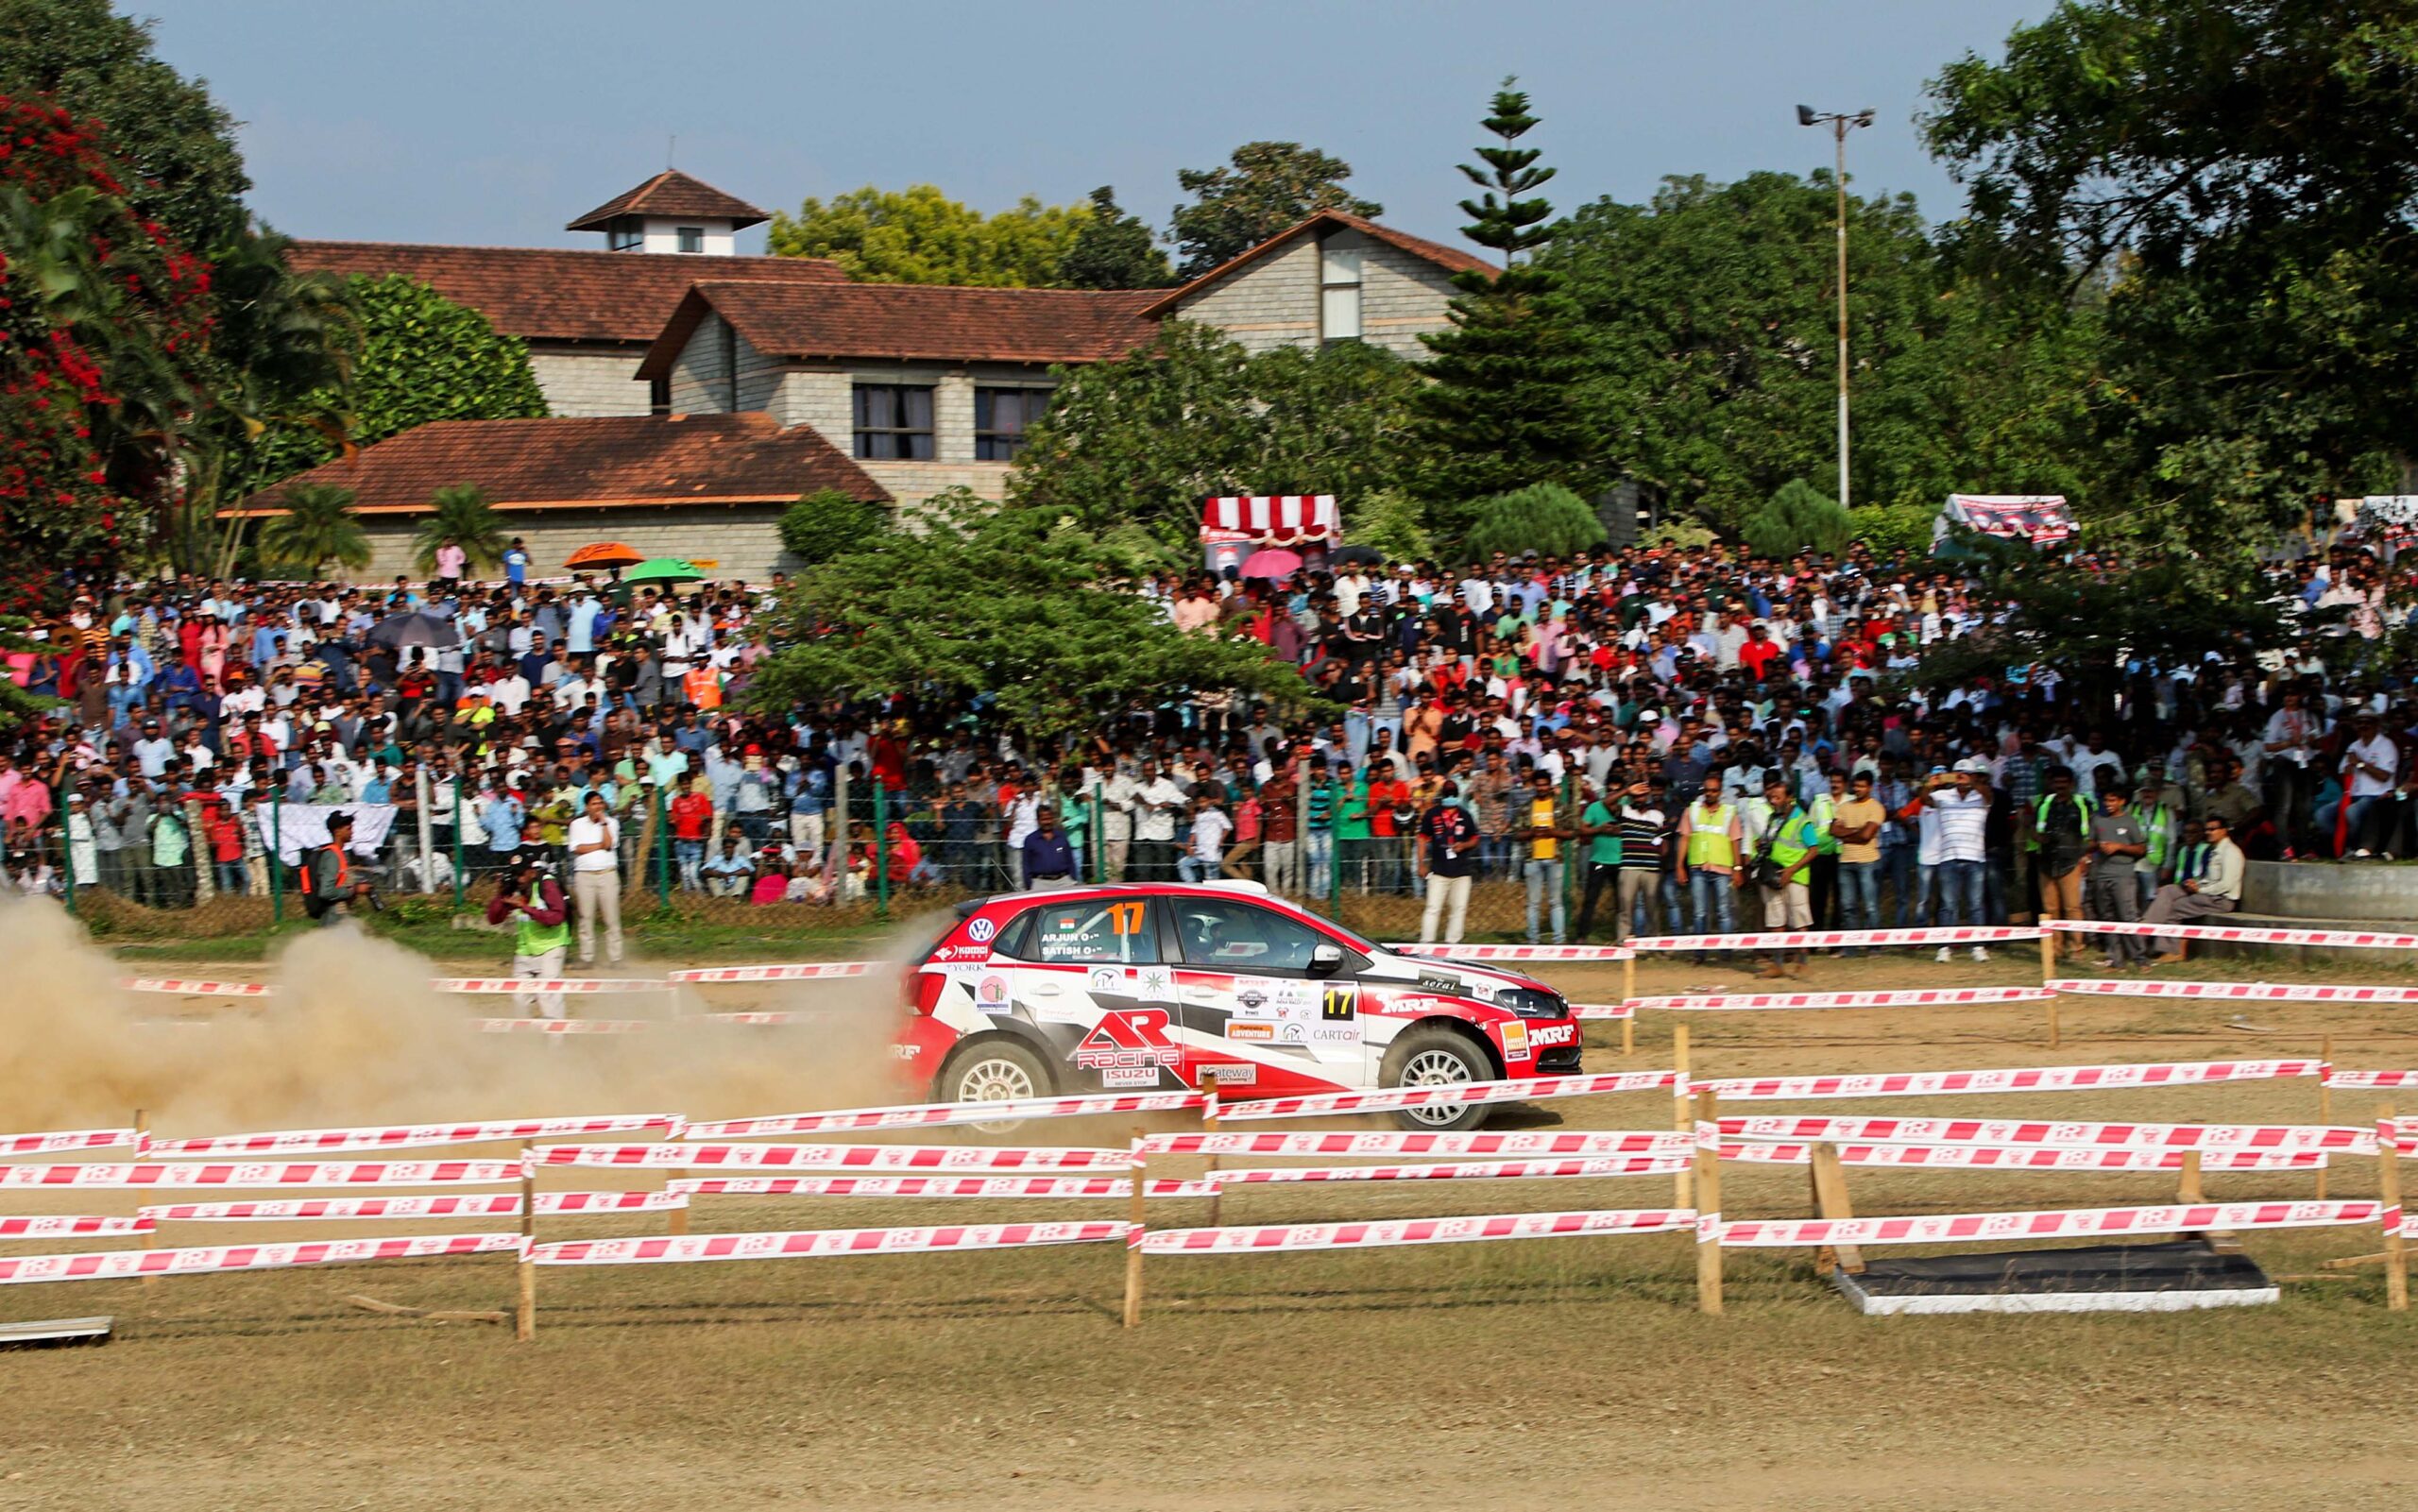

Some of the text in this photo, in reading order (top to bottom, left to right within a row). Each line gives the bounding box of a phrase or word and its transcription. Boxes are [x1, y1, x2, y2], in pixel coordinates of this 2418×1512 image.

[1106, 902, 1145, 934] 17
[1042, 933, 1078, 943] ARJUN
[1042, 946, 1081, 956] SATISH
[1324, 989, 1354, 1015] 17
[1381, 997, 1439, 1014] MRF
[1529, 1024, 1575, 1047] MRF
[890, 1044, 922, 1061] RF
[1106, 1068, 1156, 1079] ISUZU
